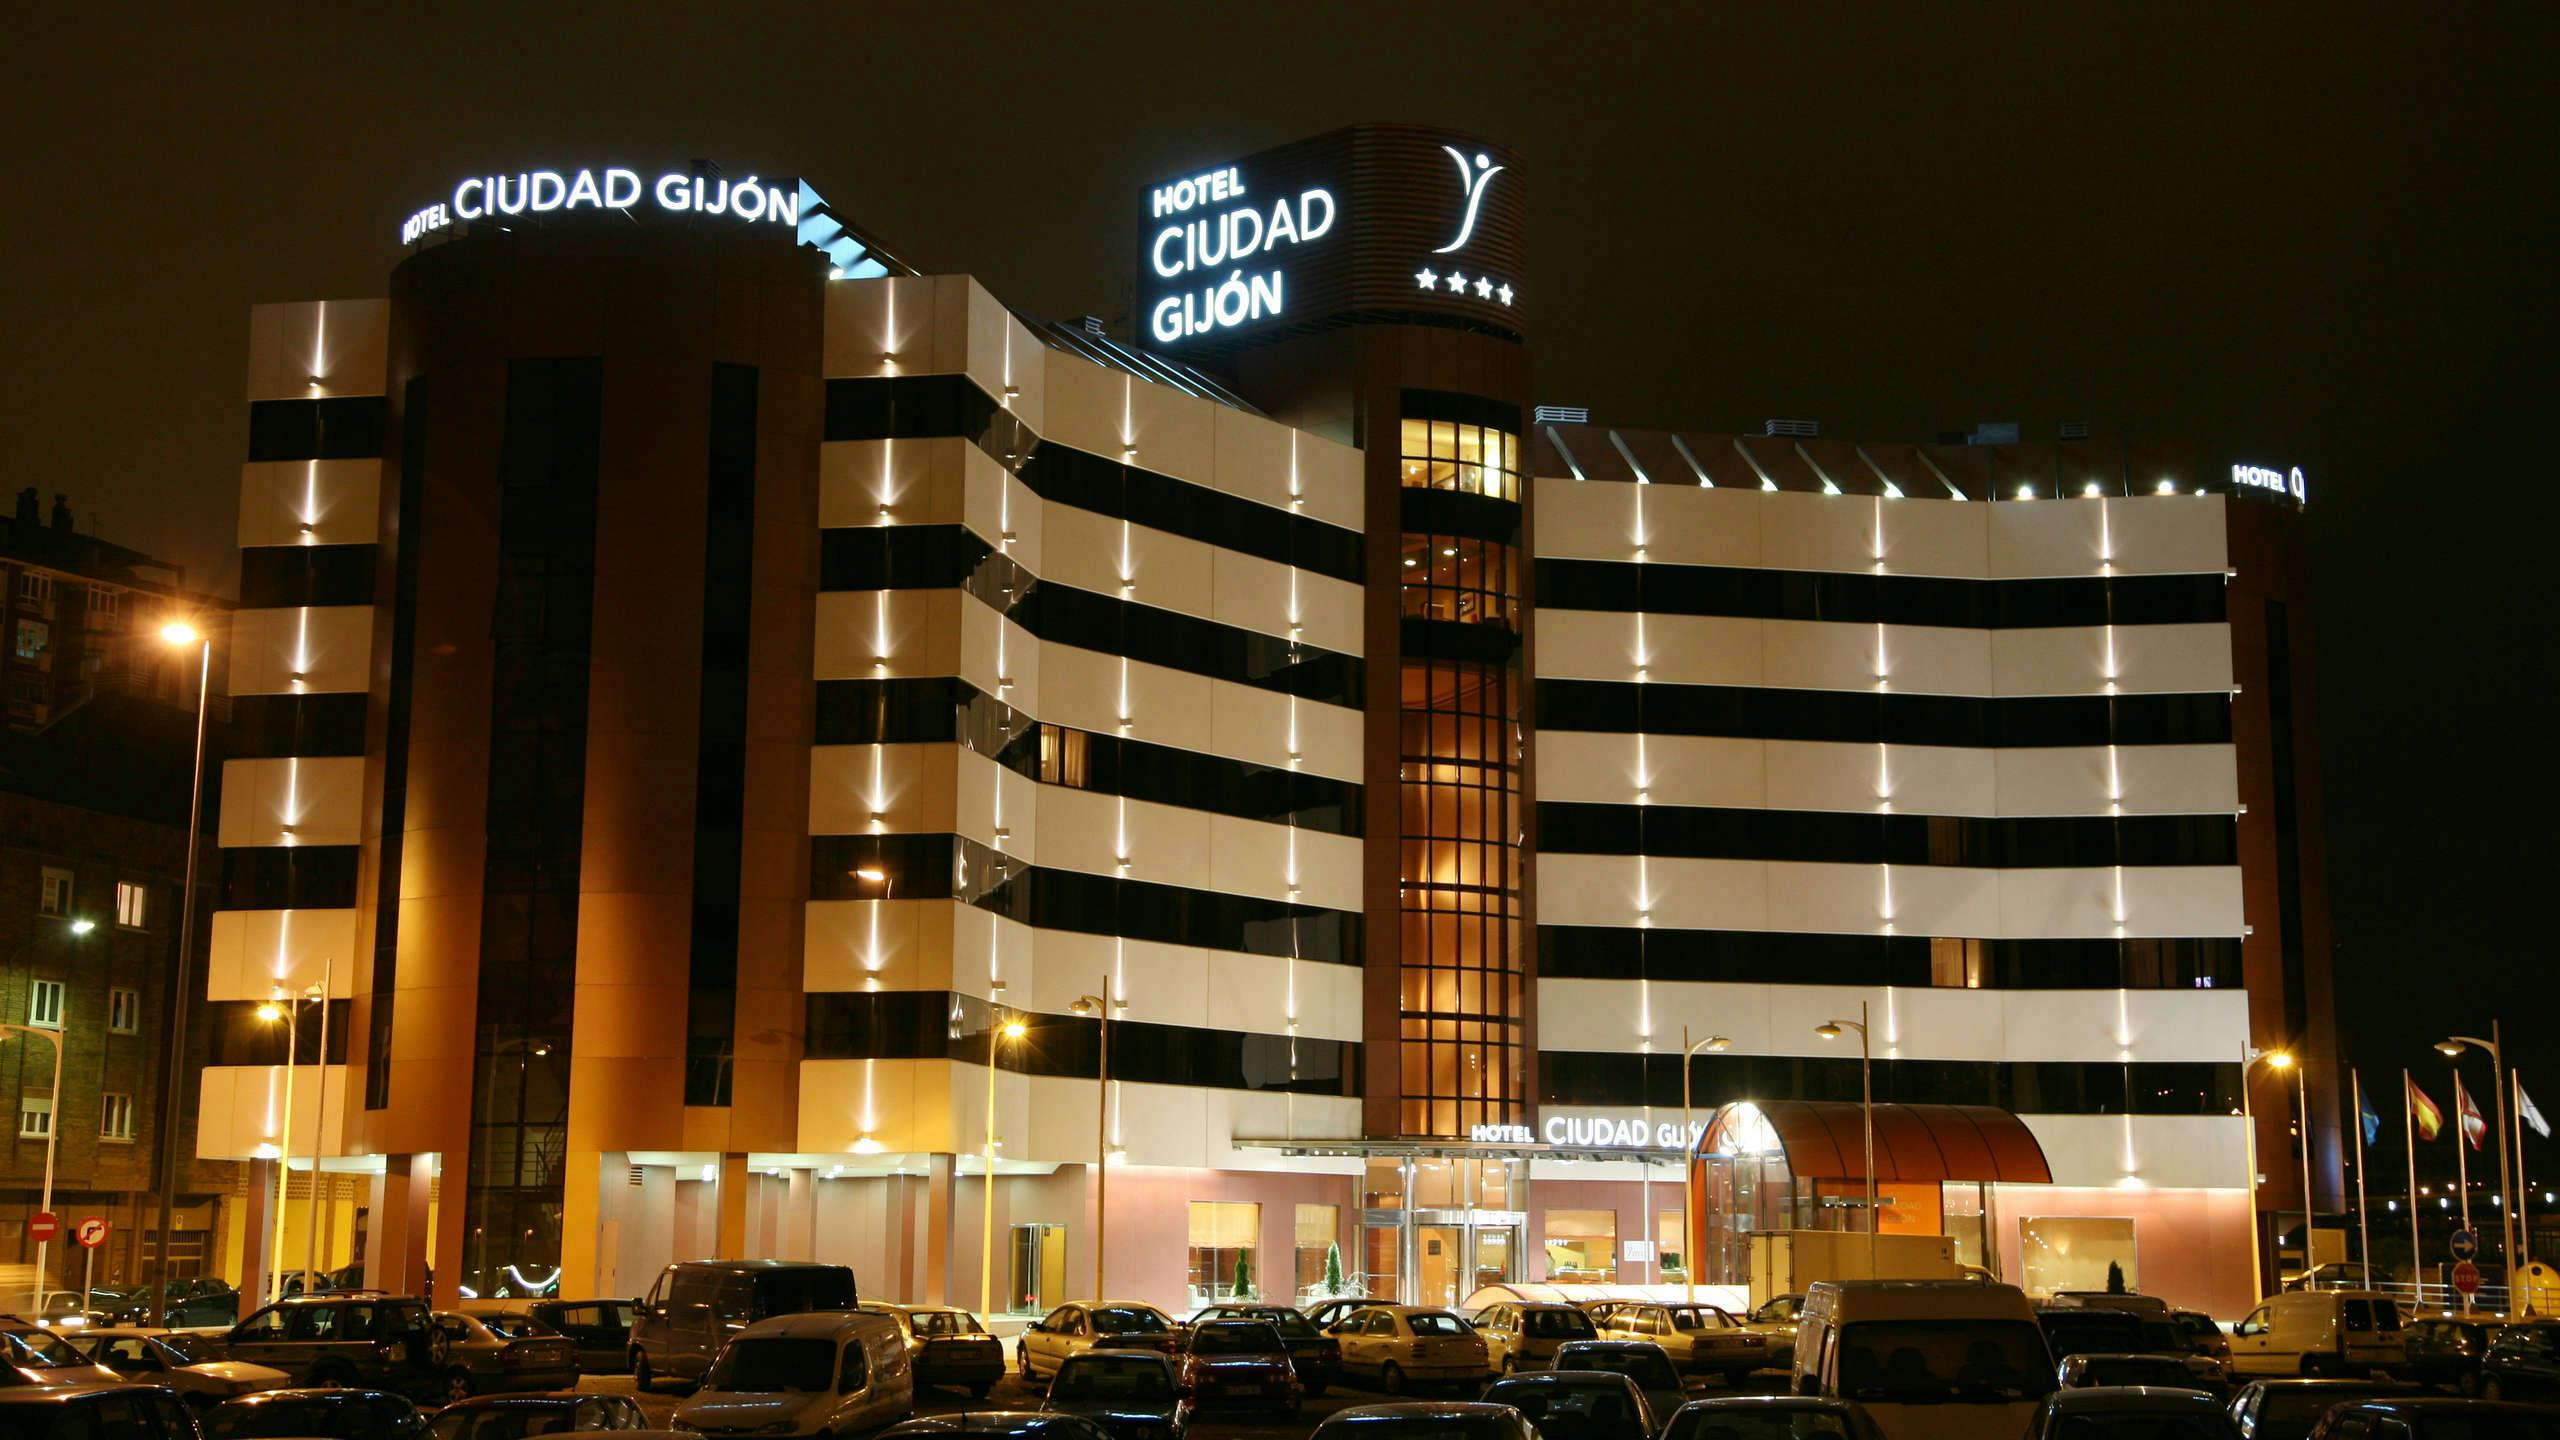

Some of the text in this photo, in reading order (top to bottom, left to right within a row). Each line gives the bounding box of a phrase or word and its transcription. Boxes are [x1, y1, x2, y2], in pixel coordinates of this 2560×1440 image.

[402, 168, 798, 245] HOTEL CIUDAD GIJÓN
[1153, 167, 1245, 218] HOTEL
[1152, 188, 1335, 278] CIUDAD
[1152, 269, 1283, 343] GIJÓN
[2231, 464, 2286, 493] HOTEL
[1471, 1124, 1535, 1143] HOTEL
[1545, 1116, 1650, 1147] CIUDAD
